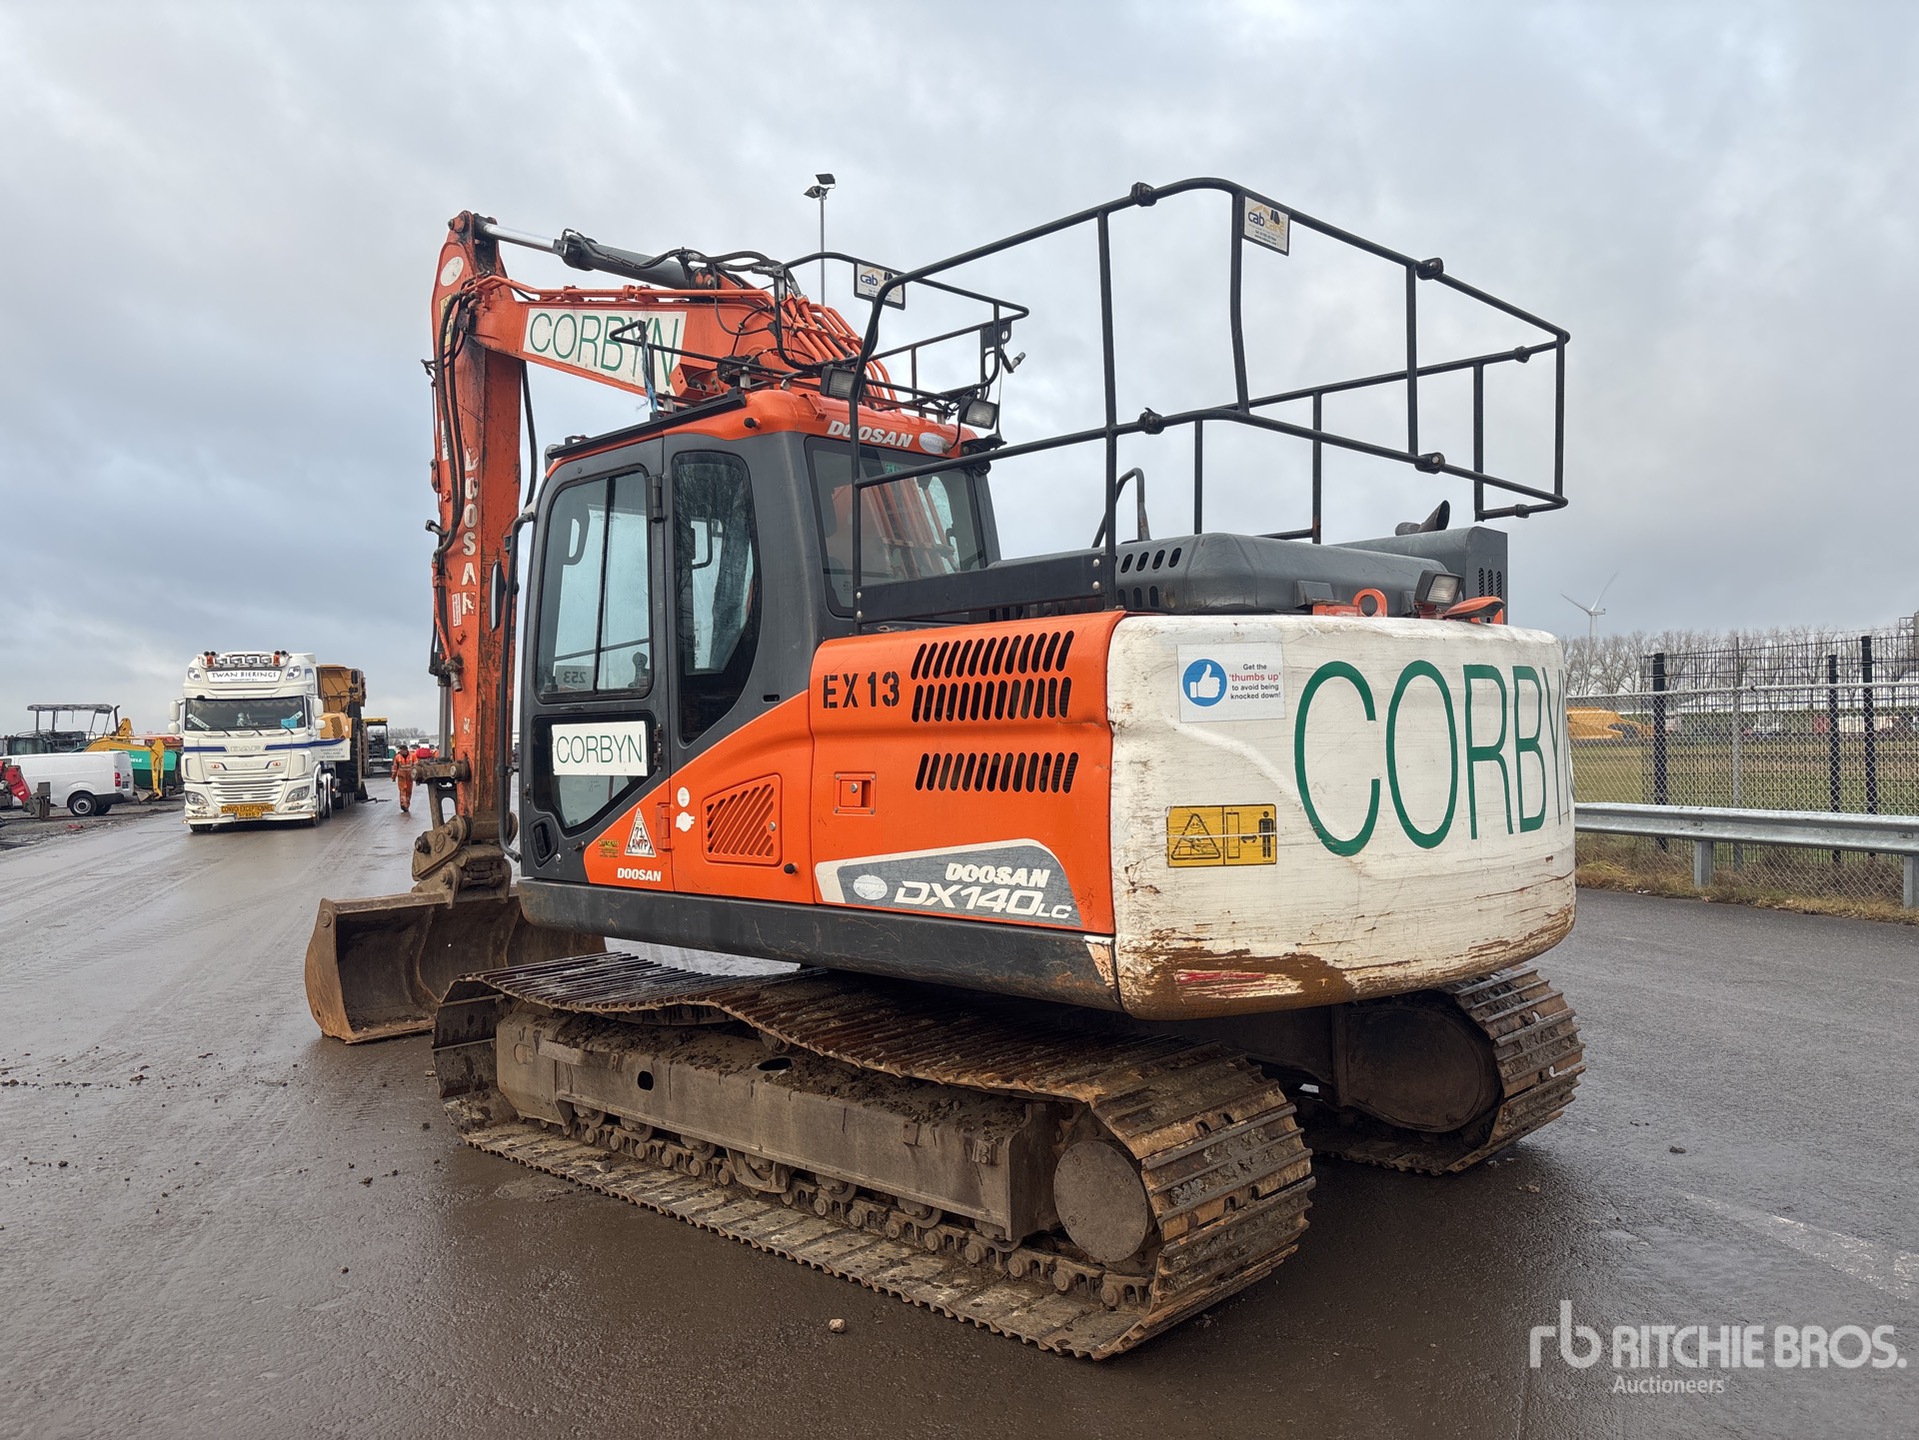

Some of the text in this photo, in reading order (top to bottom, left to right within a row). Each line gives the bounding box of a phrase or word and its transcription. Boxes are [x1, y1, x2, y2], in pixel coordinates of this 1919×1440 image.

[1248, 212, 1264, 226] cab
[860, 274, 878, 286] cab
[530, 312, 678, 387] CORBYN
[828, 420, 914, 448] DOOSAN
[823, 671, 900, 708] EX 13
[556, 734, 642, 763] CORBYN
[617, 868, 661, 882] DOOSAN
[945, 862, 1050, 888] DOOSAN
